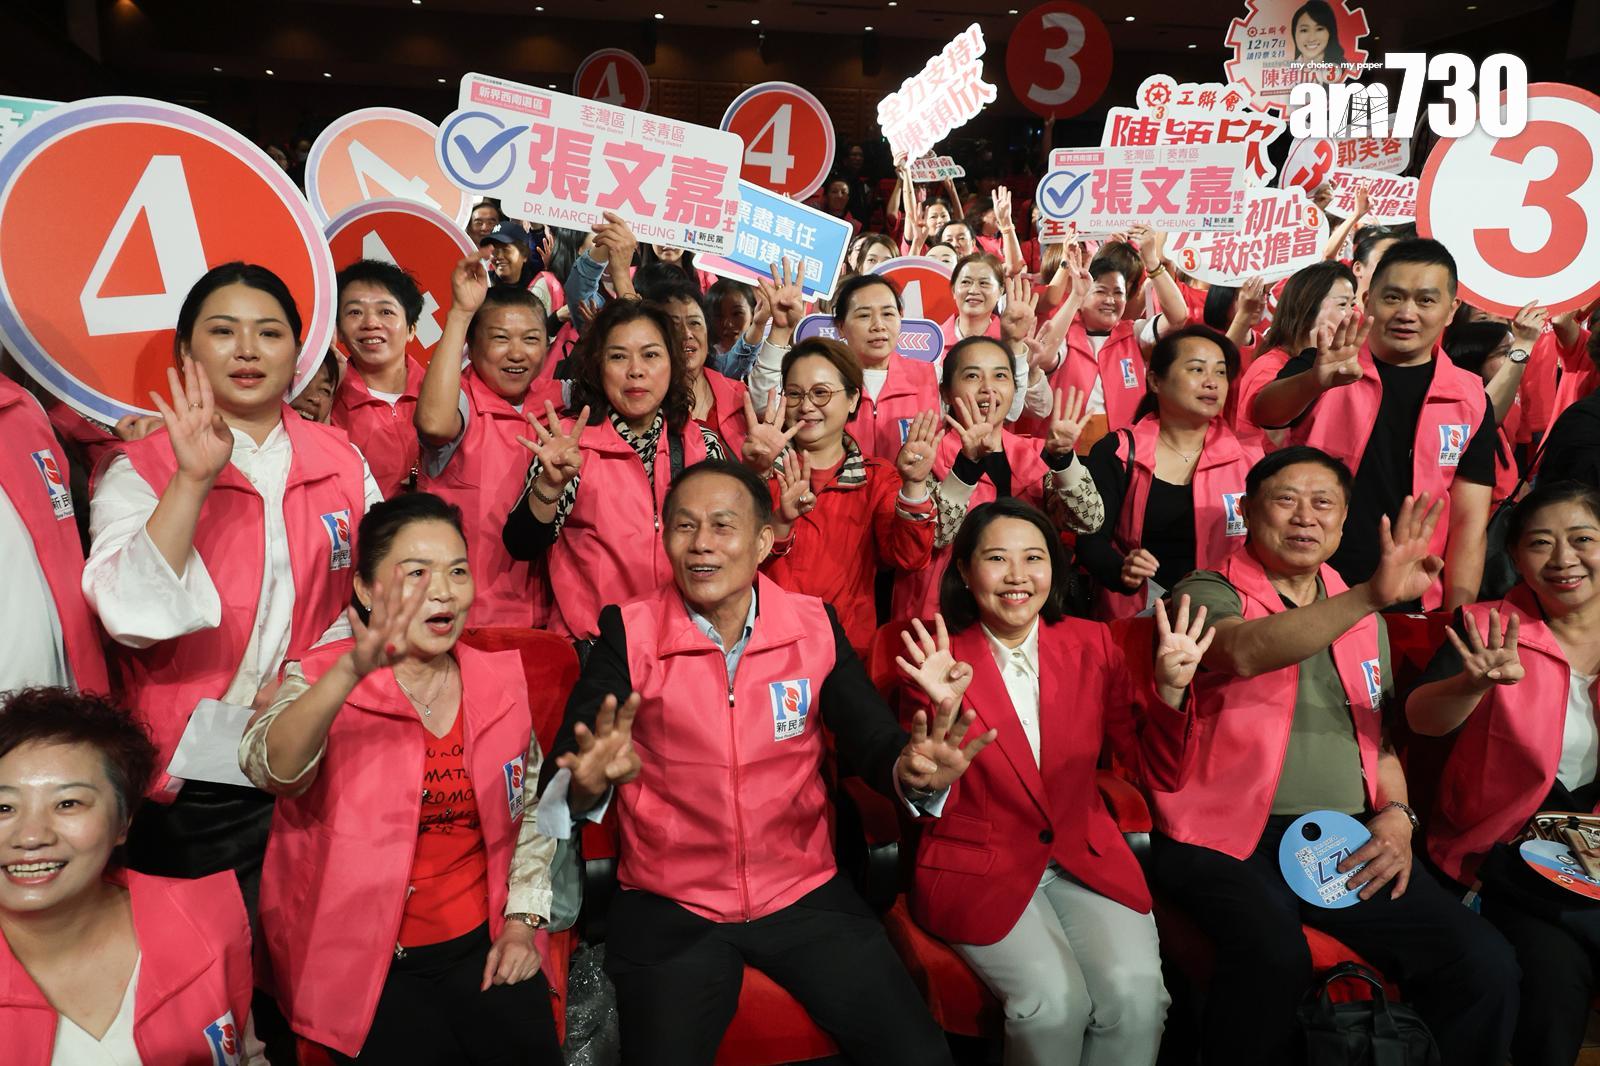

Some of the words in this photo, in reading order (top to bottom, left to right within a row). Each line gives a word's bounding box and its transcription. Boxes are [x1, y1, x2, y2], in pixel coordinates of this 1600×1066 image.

[1247, 39, 1286, 50] 12月7日
[1027, 12, 1086, 105] 3
[593, 61, 626, 102] 4
[893, 66, 990, 152] 陳穎欣
[1155, 106, 1165, 119] 3
[1177, 90, 1244, 111] 工聯會
[580, 104, 625, 129] 荃灣區
[642, 118, 686, 142] 葵青區
[744, 104, 795, 184] 4
[526, 122, 729, 231] 張文嘉
[1090, 166, 1235, 214] 張文嘉
[1232, 190, 1245, 214] 博士
[1473, 119, 1594, 278] 3
[523, 202, 545, 216] DR.
[721, 199, 739, 233] 博士
[1307, 206, 1319, 227] 3
[1089, 219, 1104, 228] DR.
[1156, 219, 1196, 228] CHEUNG
[80, 155, 209, 337] 4
[698, 232, 724, 244] 新民黨
[1183, 249, 1196, 271] 3
[1200, 227, 1319, 276] 敢於擔當
